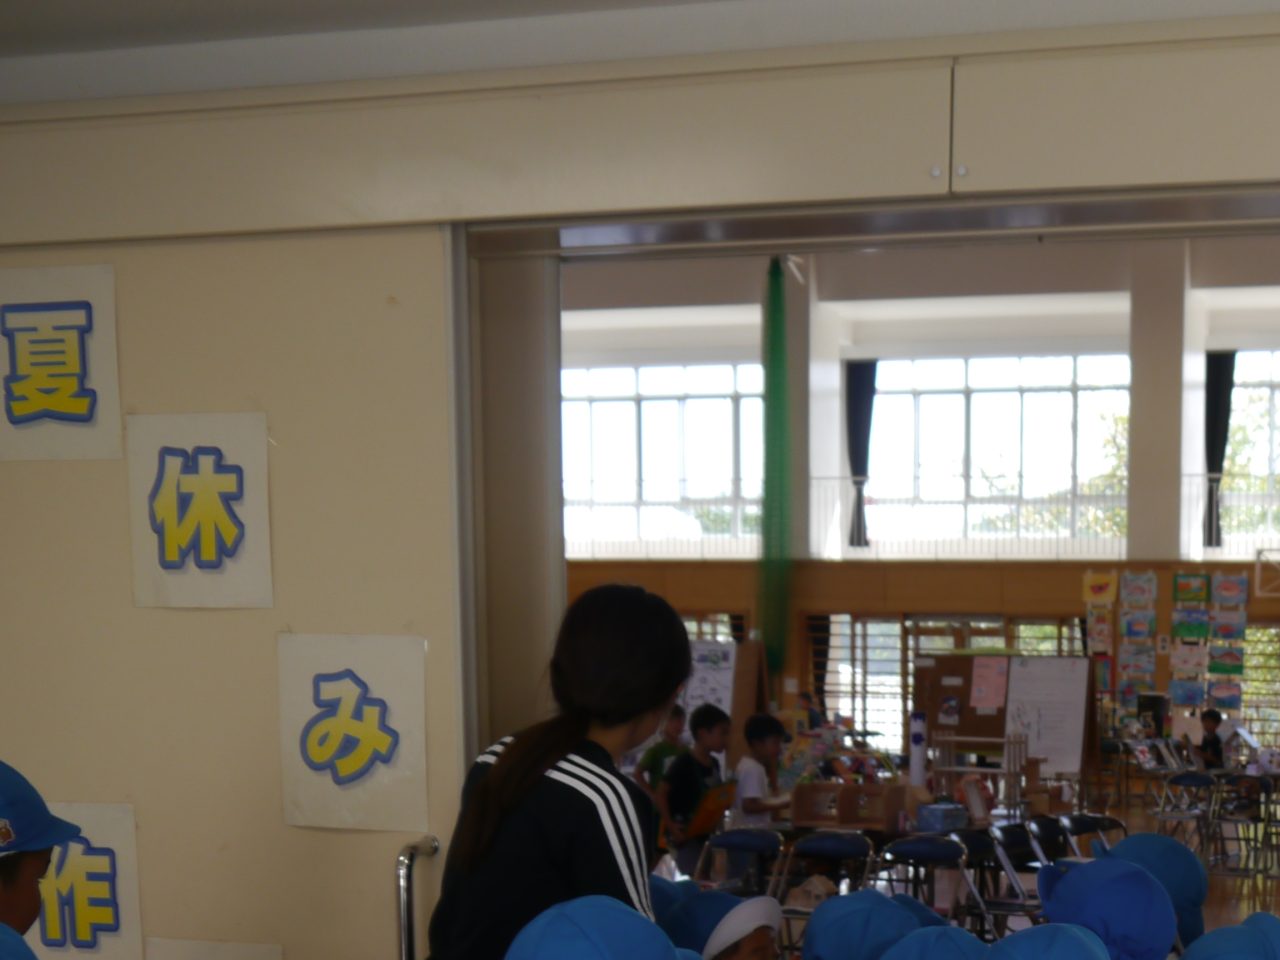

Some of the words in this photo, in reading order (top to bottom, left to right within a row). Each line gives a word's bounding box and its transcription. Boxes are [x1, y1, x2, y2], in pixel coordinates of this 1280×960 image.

[2, 301, 97, 425] 夏
[149, 446, 244, 570] 休
[300, 668, 399, 786] み
[39, 836, 119, 948] 作
